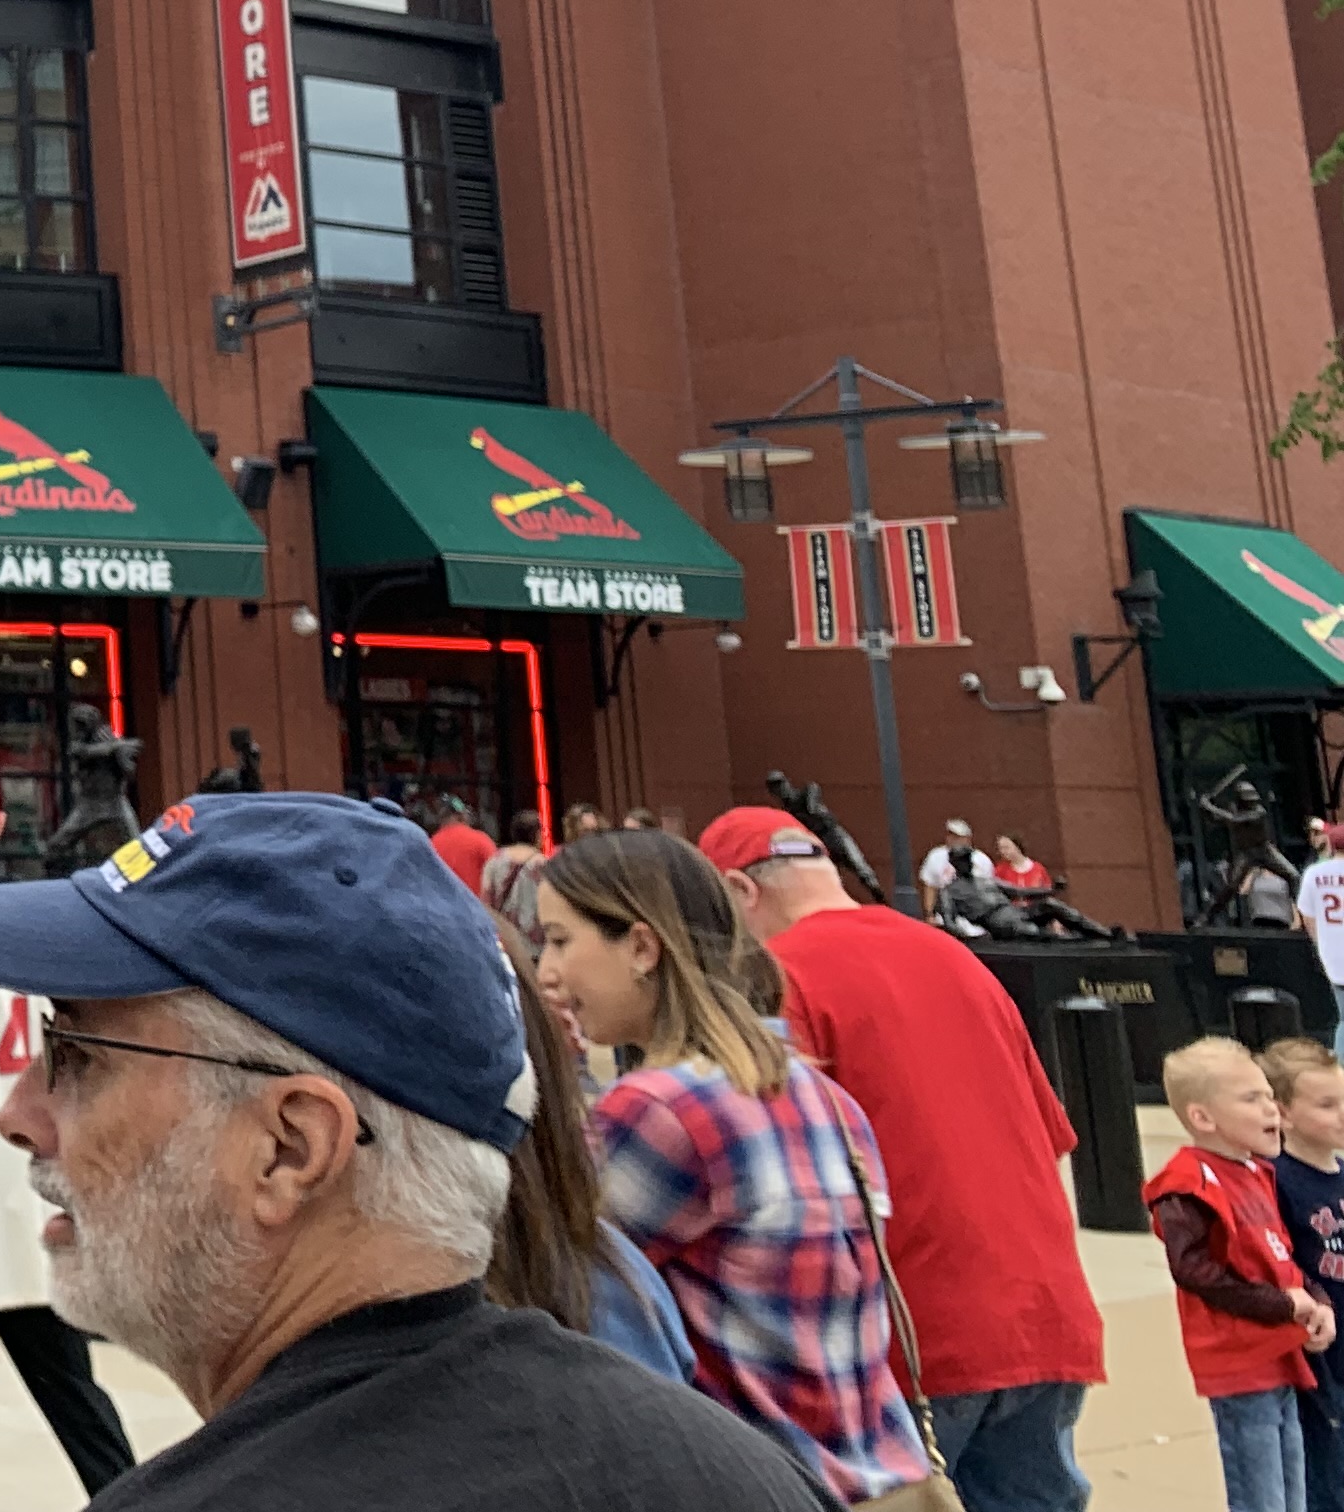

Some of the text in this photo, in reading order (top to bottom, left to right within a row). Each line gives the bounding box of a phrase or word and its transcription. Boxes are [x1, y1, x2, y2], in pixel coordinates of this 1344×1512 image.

[60, 558, 173, 592] STORE
[524, 575, 685, 614] TEAM STORE
